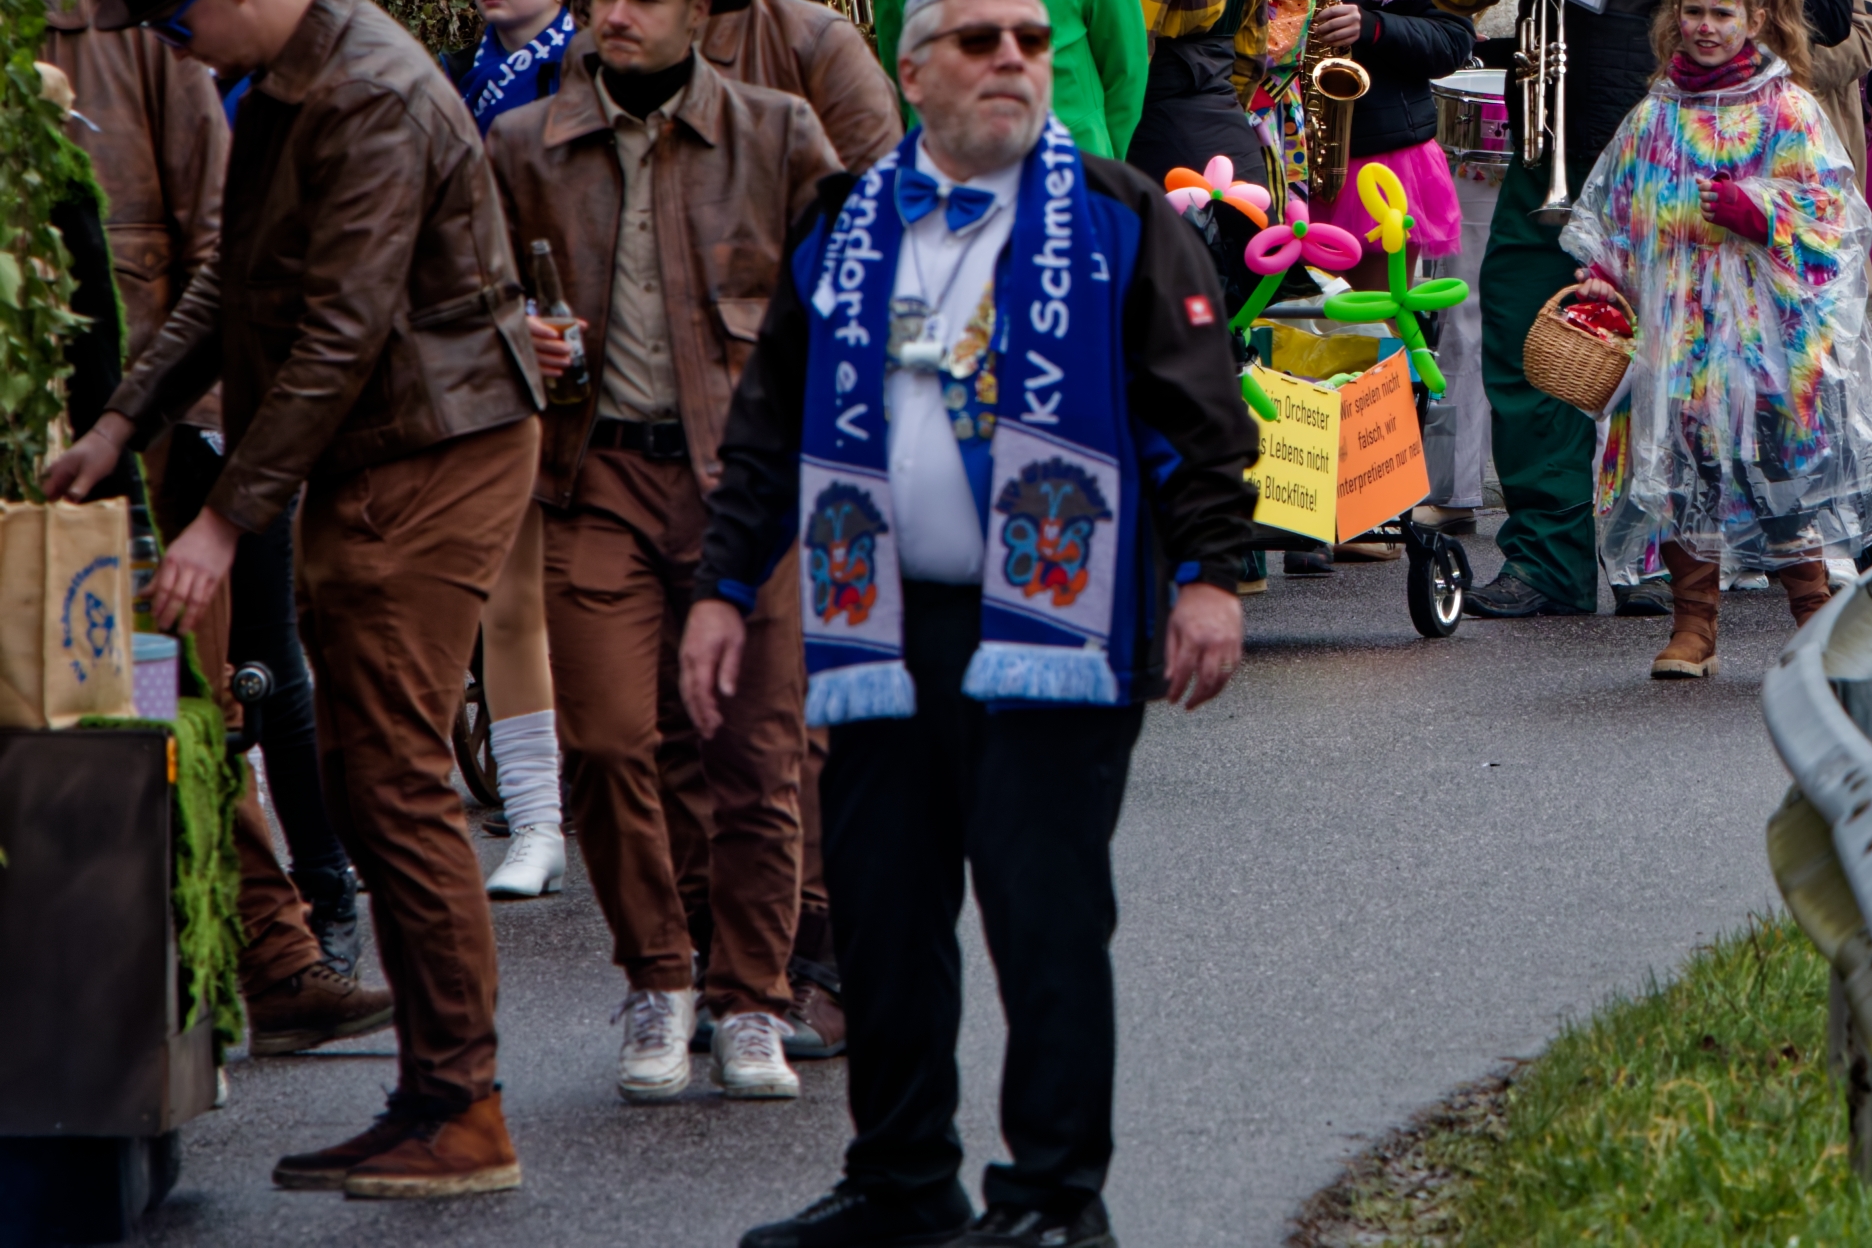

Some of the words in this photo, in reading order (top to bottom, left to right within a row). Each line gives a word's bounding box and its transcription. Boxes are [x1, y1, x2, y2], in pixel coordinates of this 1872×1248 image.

[836, 361, 870, 447] e.V.
[1020, 350, 1064, 424] KV
[1355, 386, 1381, 416] spielen
[1382, 371, 1401, 398] nicht
[1285, 395, 1330, 431] Orchester
[1358, 421, 1385, 450] falsch,
[1384, 413, 1397, 435] wir
[1270, 433, 1304, 466] Lebens
[1307, 446, 1329, 474] nicht
[1395, 449, 1408, 469] nur
[1265, 475, 1317, 513] Blockflöte!
